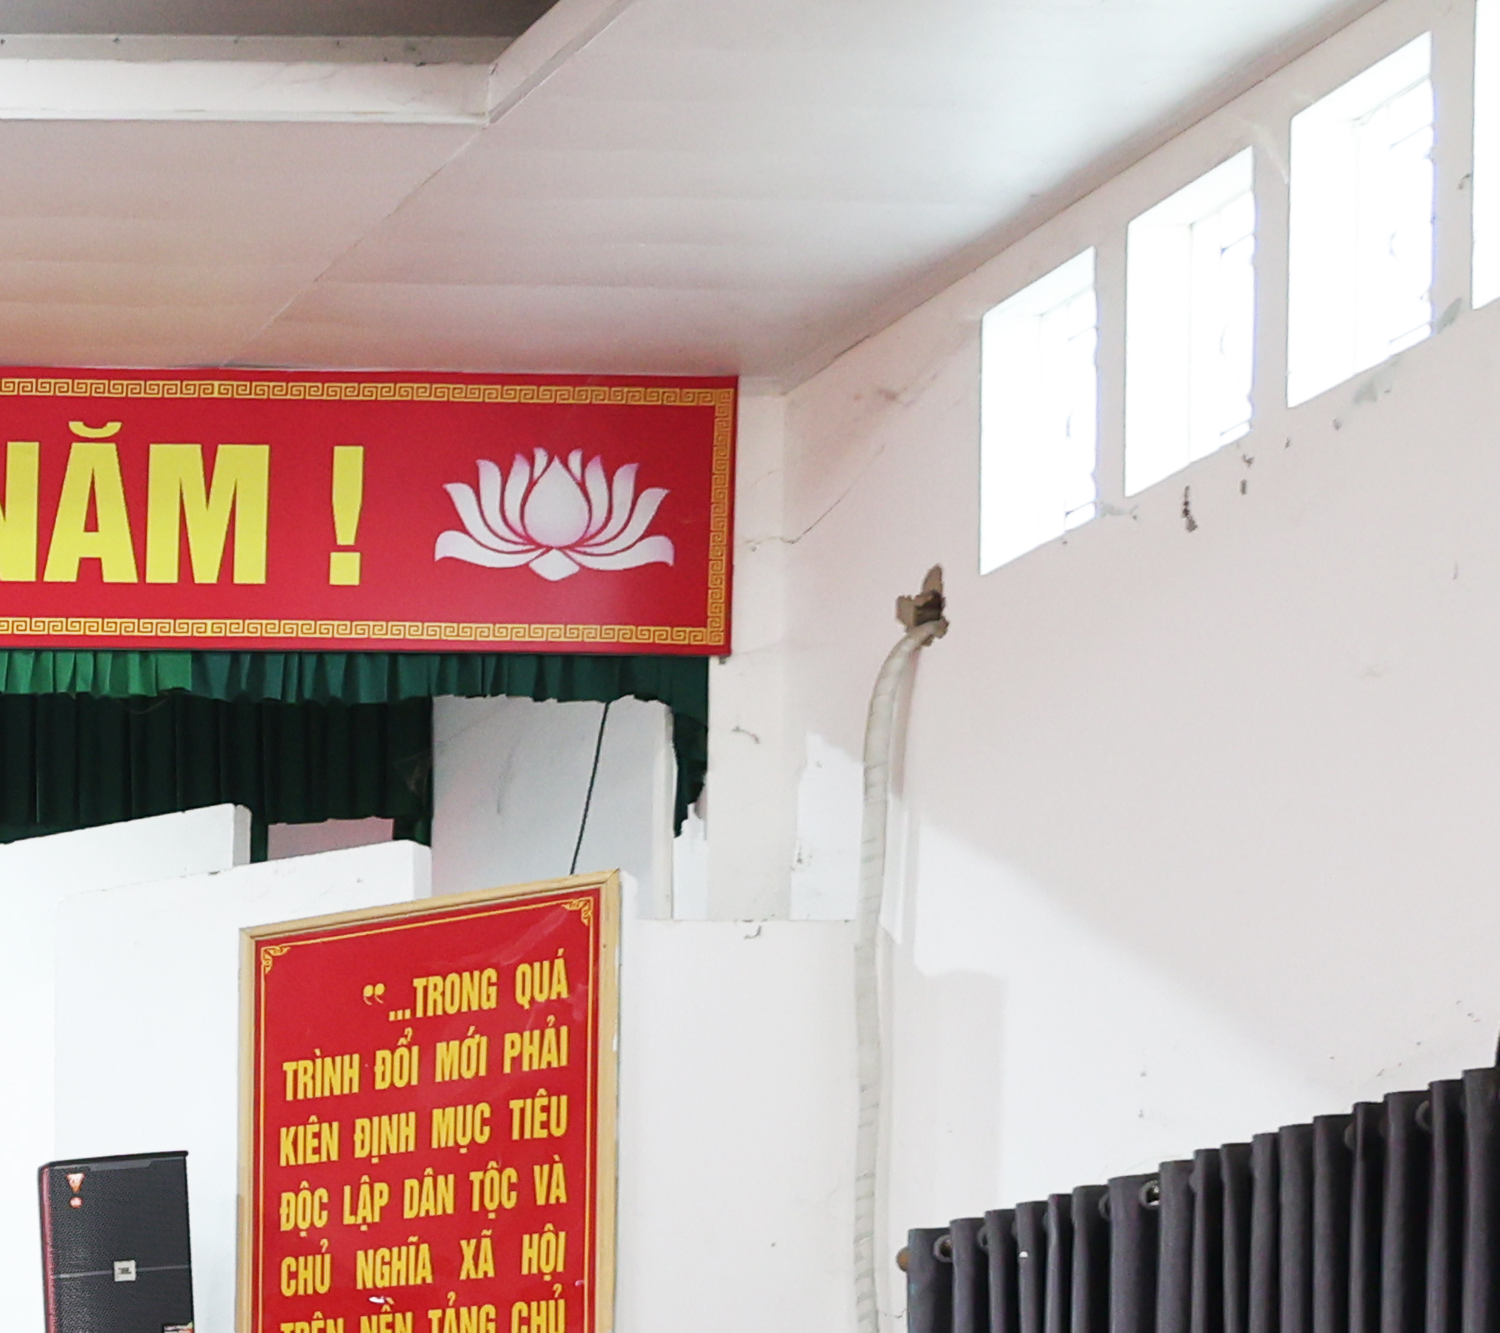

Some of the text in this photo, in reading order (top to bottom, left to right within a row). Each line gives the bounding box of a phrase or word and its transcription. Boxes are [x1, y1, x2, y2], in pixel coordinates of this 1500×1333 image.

[329, 446, 364, 585] !
[516, 949, 569, 1009] QUÁ
[283, 1016, 568, 1100] TRÌNH ĐỔI MỚI PHẢI
[280, 1089, 567, 1166] KIÊN ĐỊNH MỤC TIÊU
[281, 1224, 565, 1296] CHỦ NGHĨA XÃ HỘI
